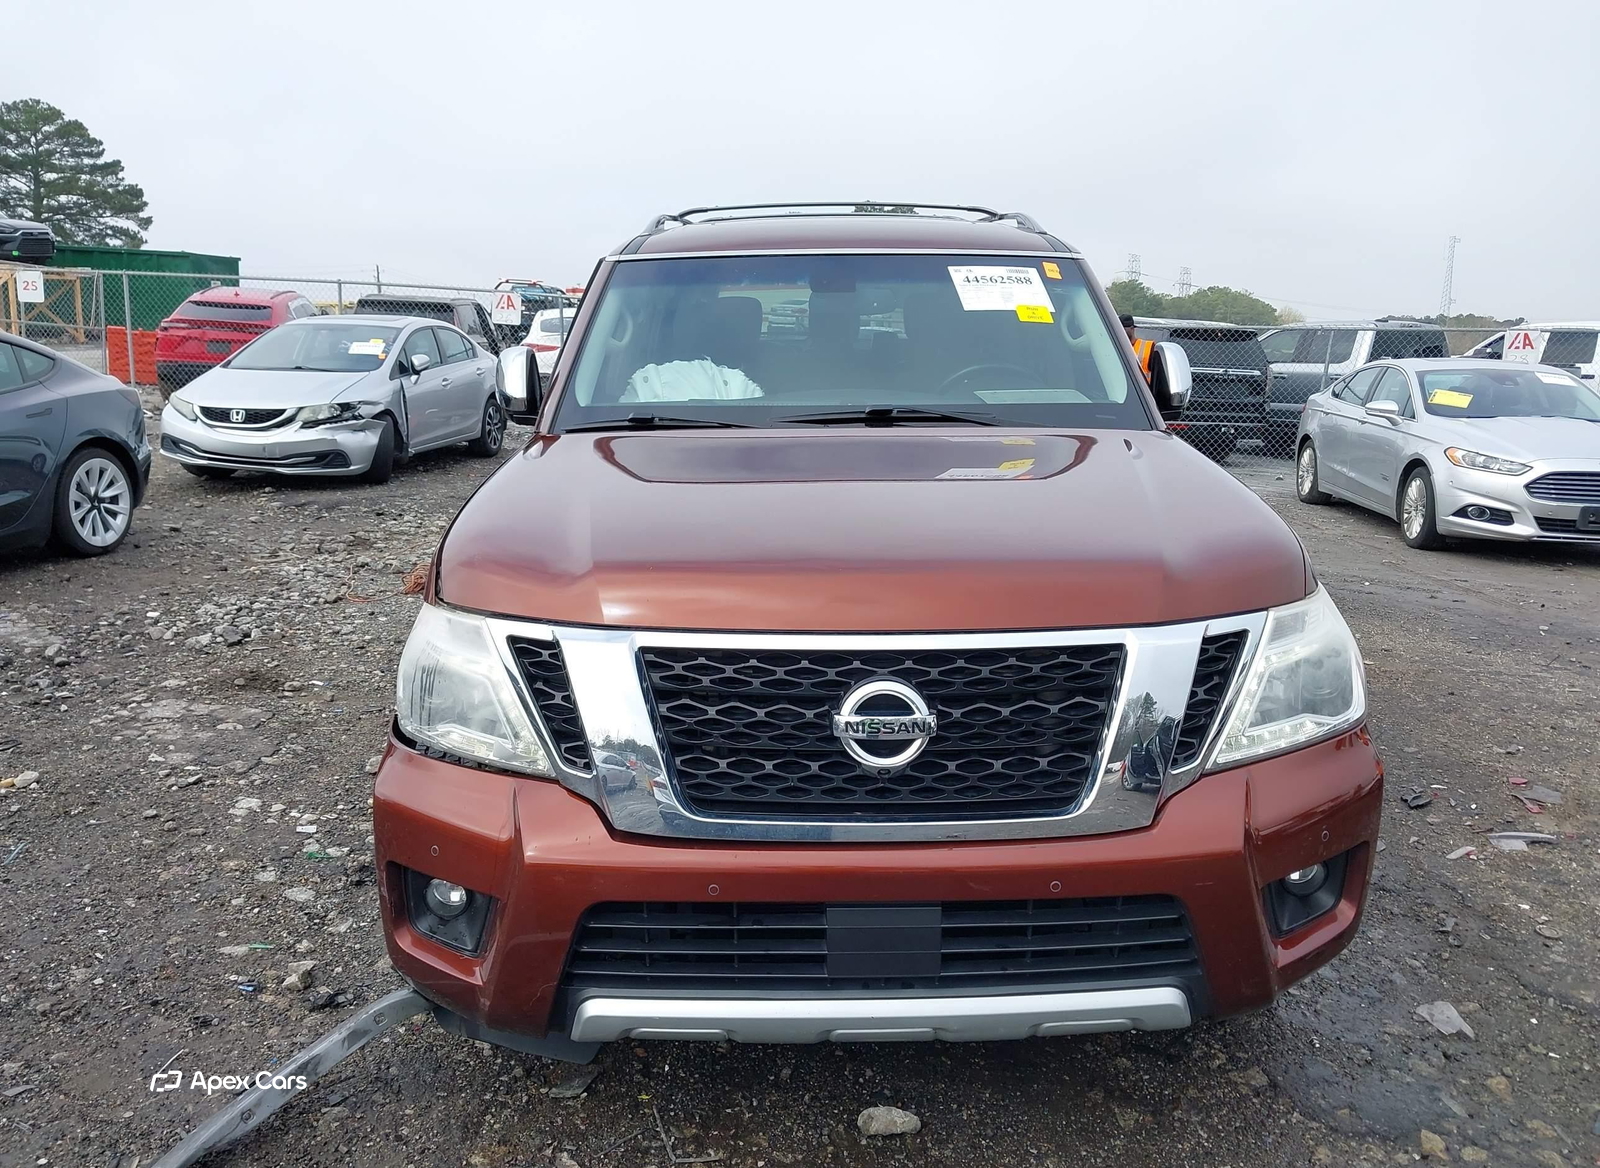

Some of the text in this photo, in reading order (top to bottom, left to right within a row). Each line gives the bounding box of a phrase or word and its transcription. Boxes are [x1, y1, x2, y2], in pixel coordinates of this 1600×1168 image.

[22, 280, 38, 291] 25
[962, 275, 1033, 285] 44562588
[844, 721, 926, 734] NISSAN
